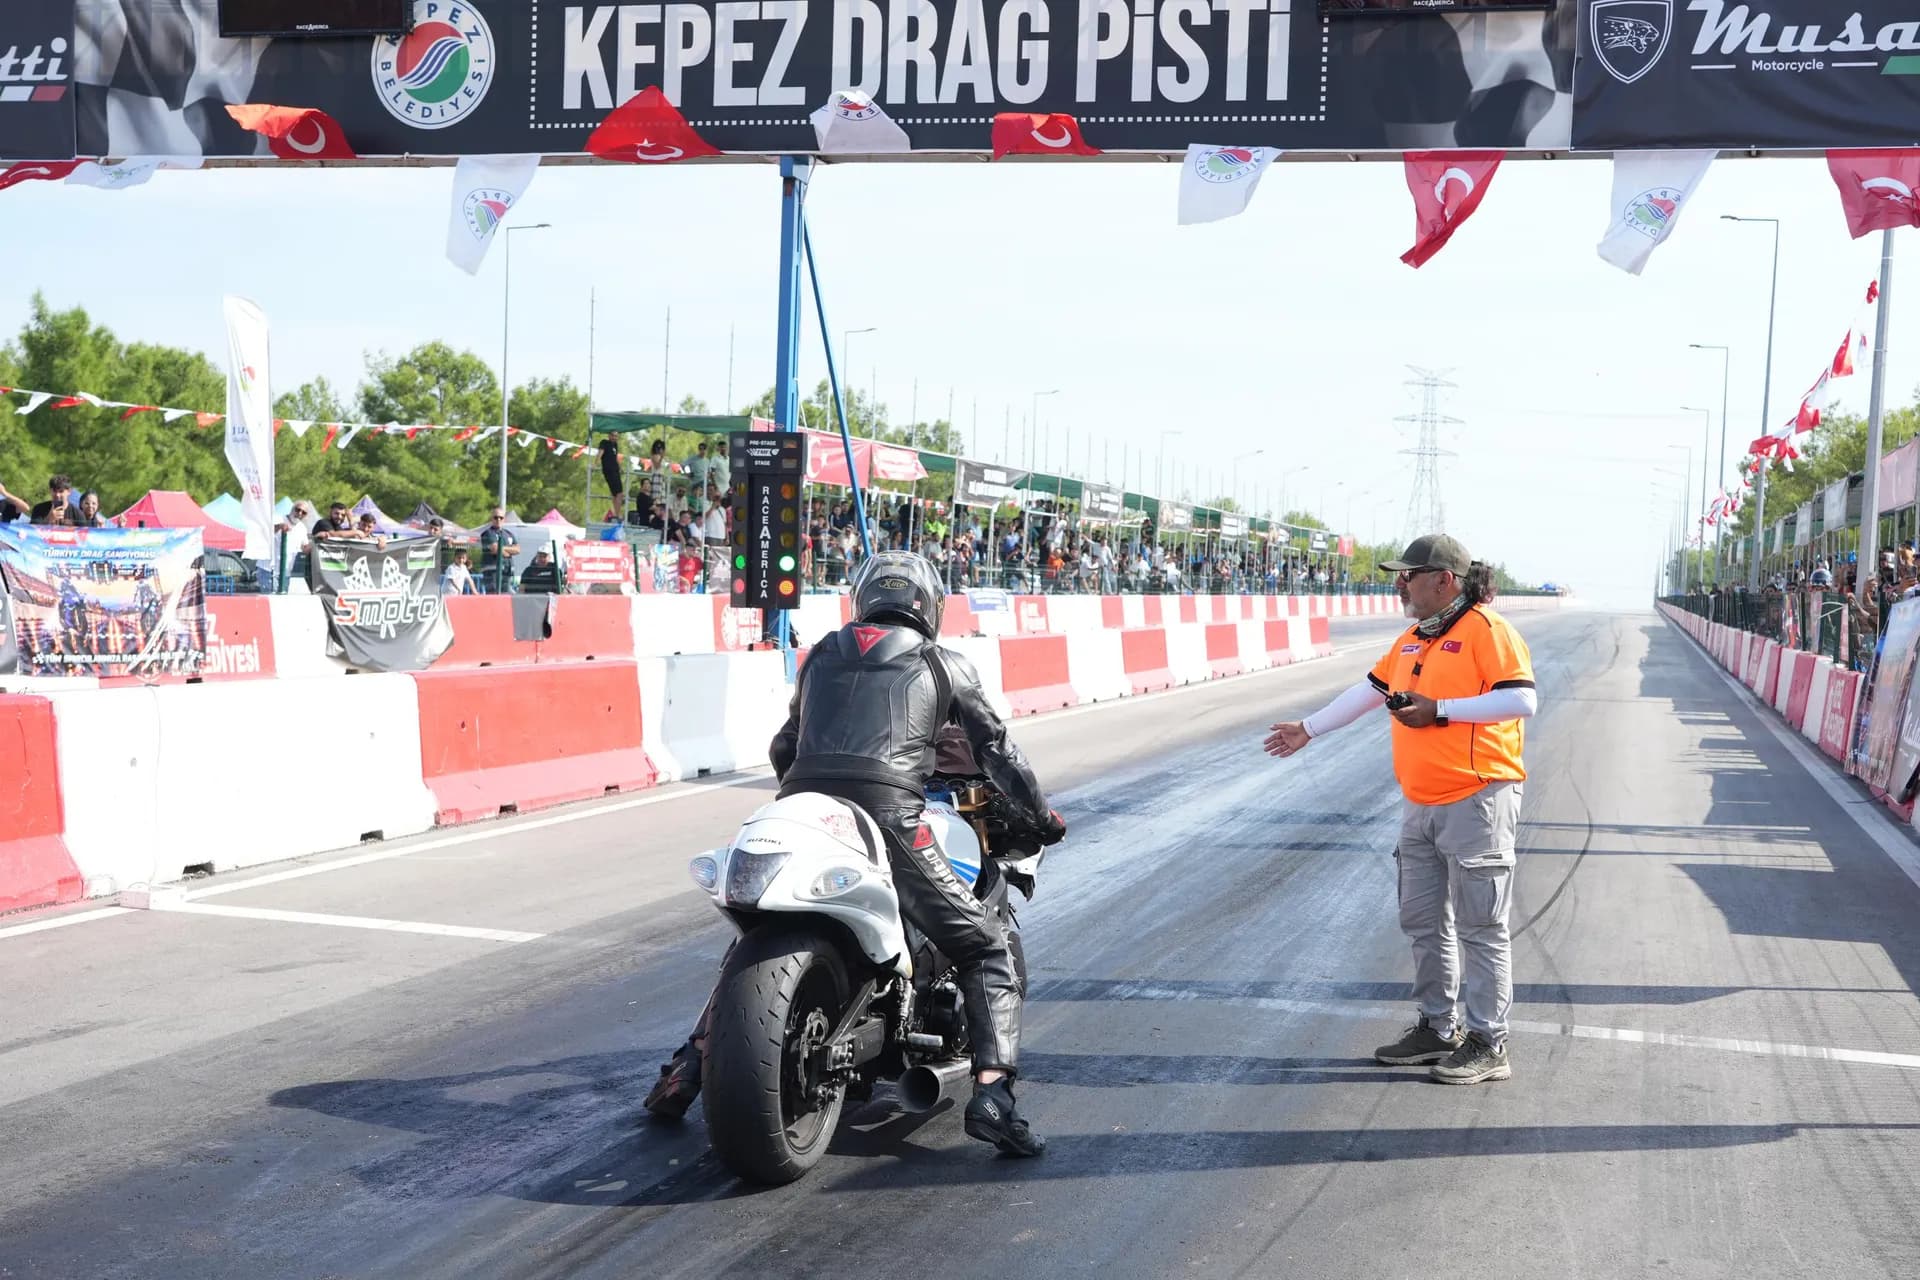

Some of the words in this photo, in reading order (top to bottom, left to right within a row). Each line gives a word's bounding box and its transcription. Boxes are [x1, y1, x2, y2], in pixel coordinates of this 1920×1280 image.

[385, 3, 482, 47] KPEZ
[562, 1, 807, 112] KEPEZ
[830, 0, 1051, 105] DRAG
[1752, 59, 1825, 73] Motorcycle
[759, 486, 772, 599] RACEAMERICA
[206, 636, 260, 674] EDİYESİ
[746, 837, 782, 846] SUZUKI
